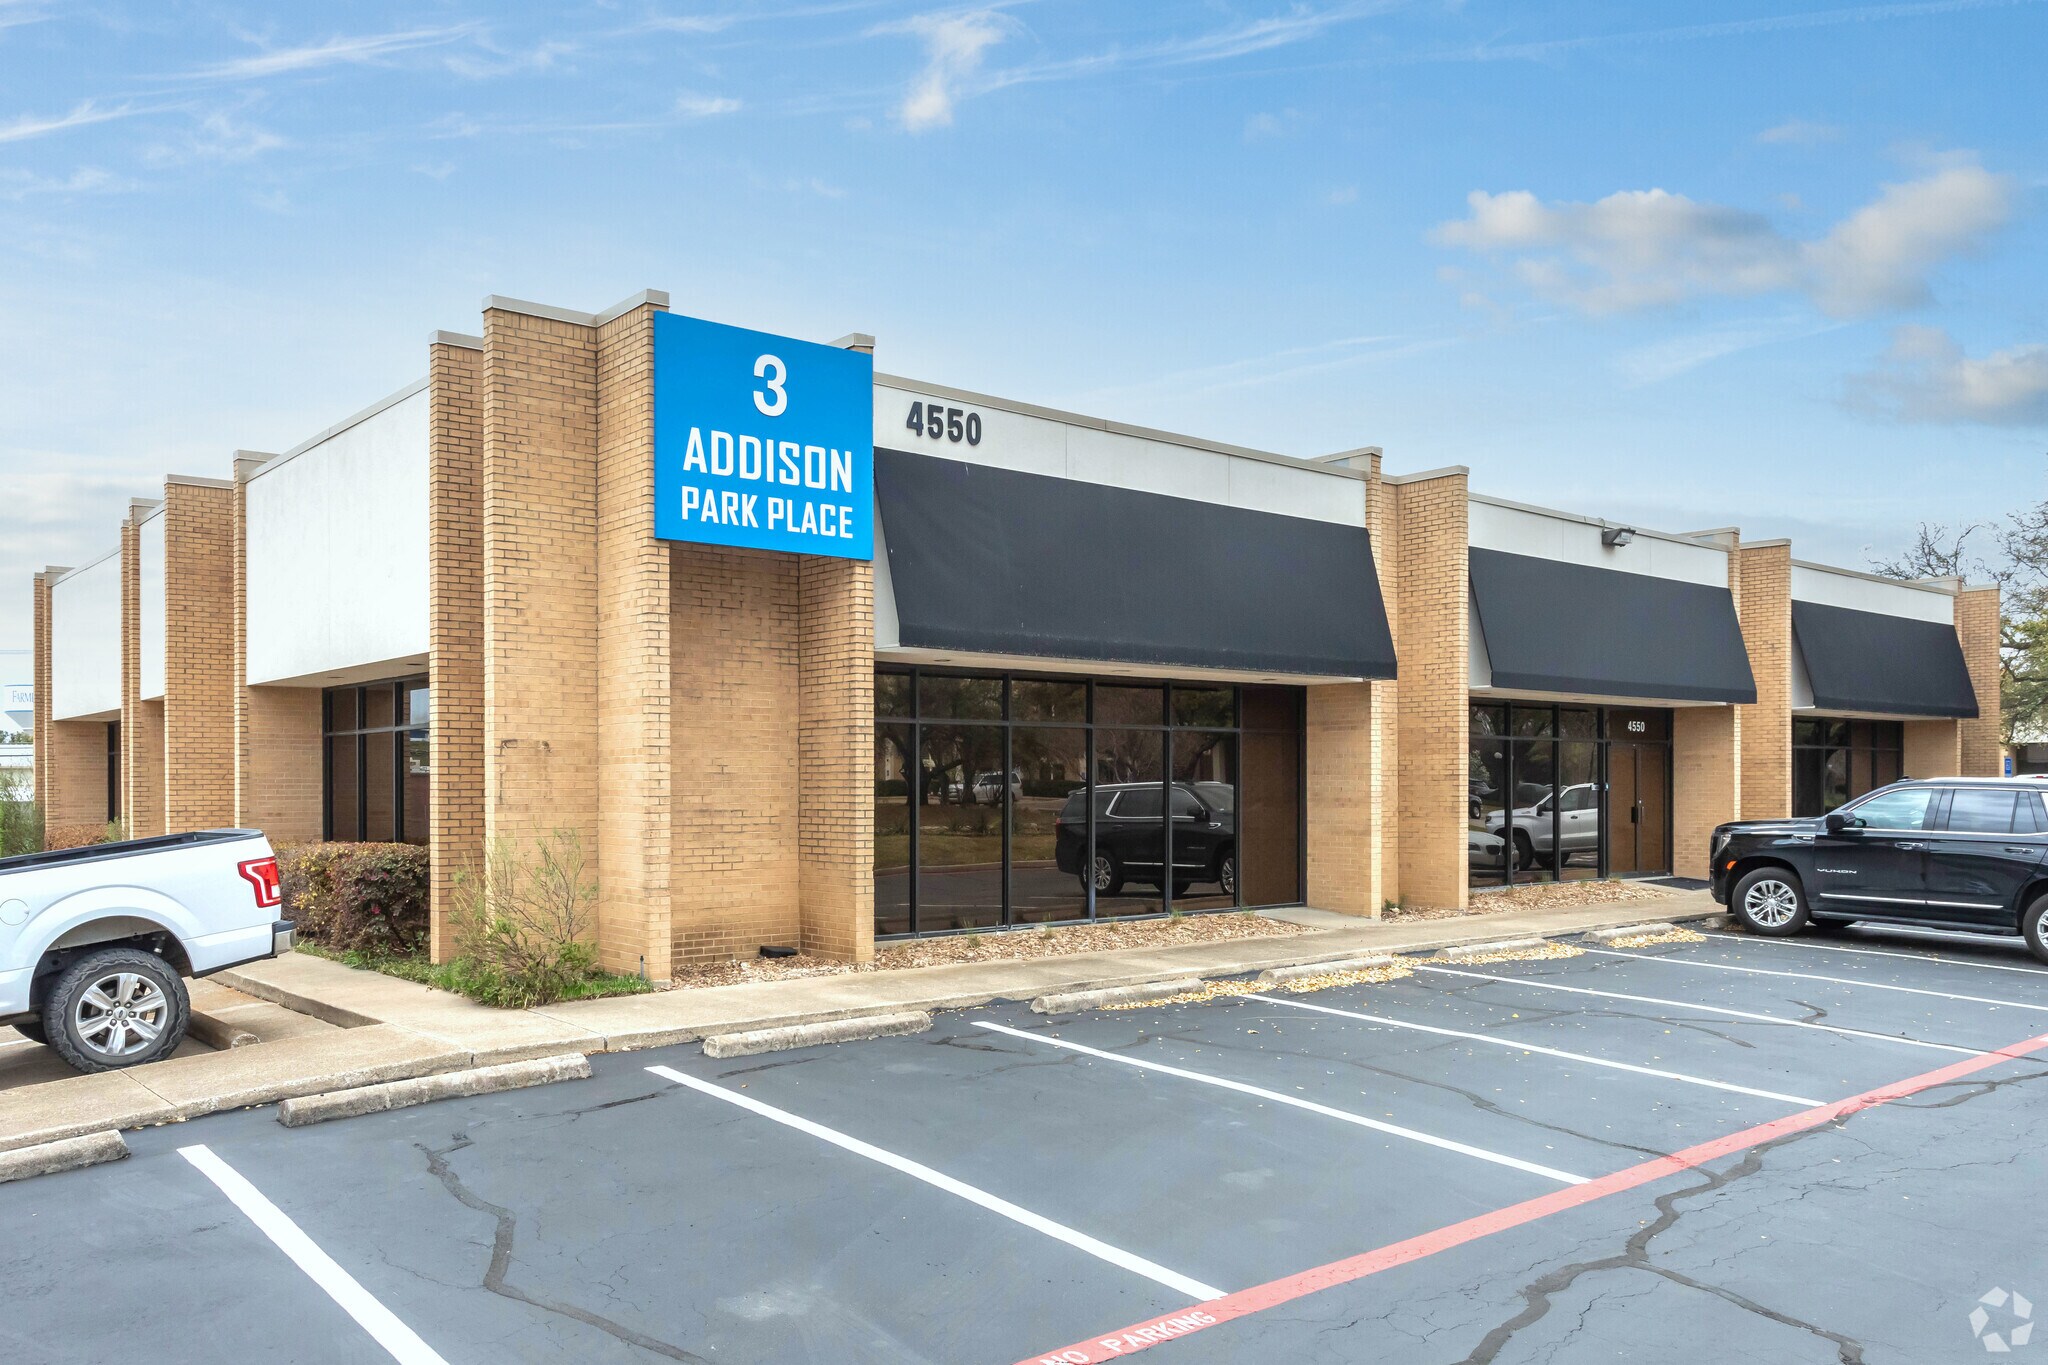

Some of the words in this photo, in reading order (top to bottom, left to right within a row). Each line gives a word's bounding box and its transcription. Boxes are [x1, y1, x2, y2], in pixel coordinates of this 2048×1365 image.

[753, 354, 788, 417] 3
[906, 401, 982, 446] 4550
[683, 426, 852, 493] ADDISON
[681, 485, 759, 529] PARK
[767, 497, 854, 539] PLACE
[12, 690, 34, 703] FARM
[1627, 720, 1646, 733] 4550
[1099, 1311, 1217, 1353] PARKING
